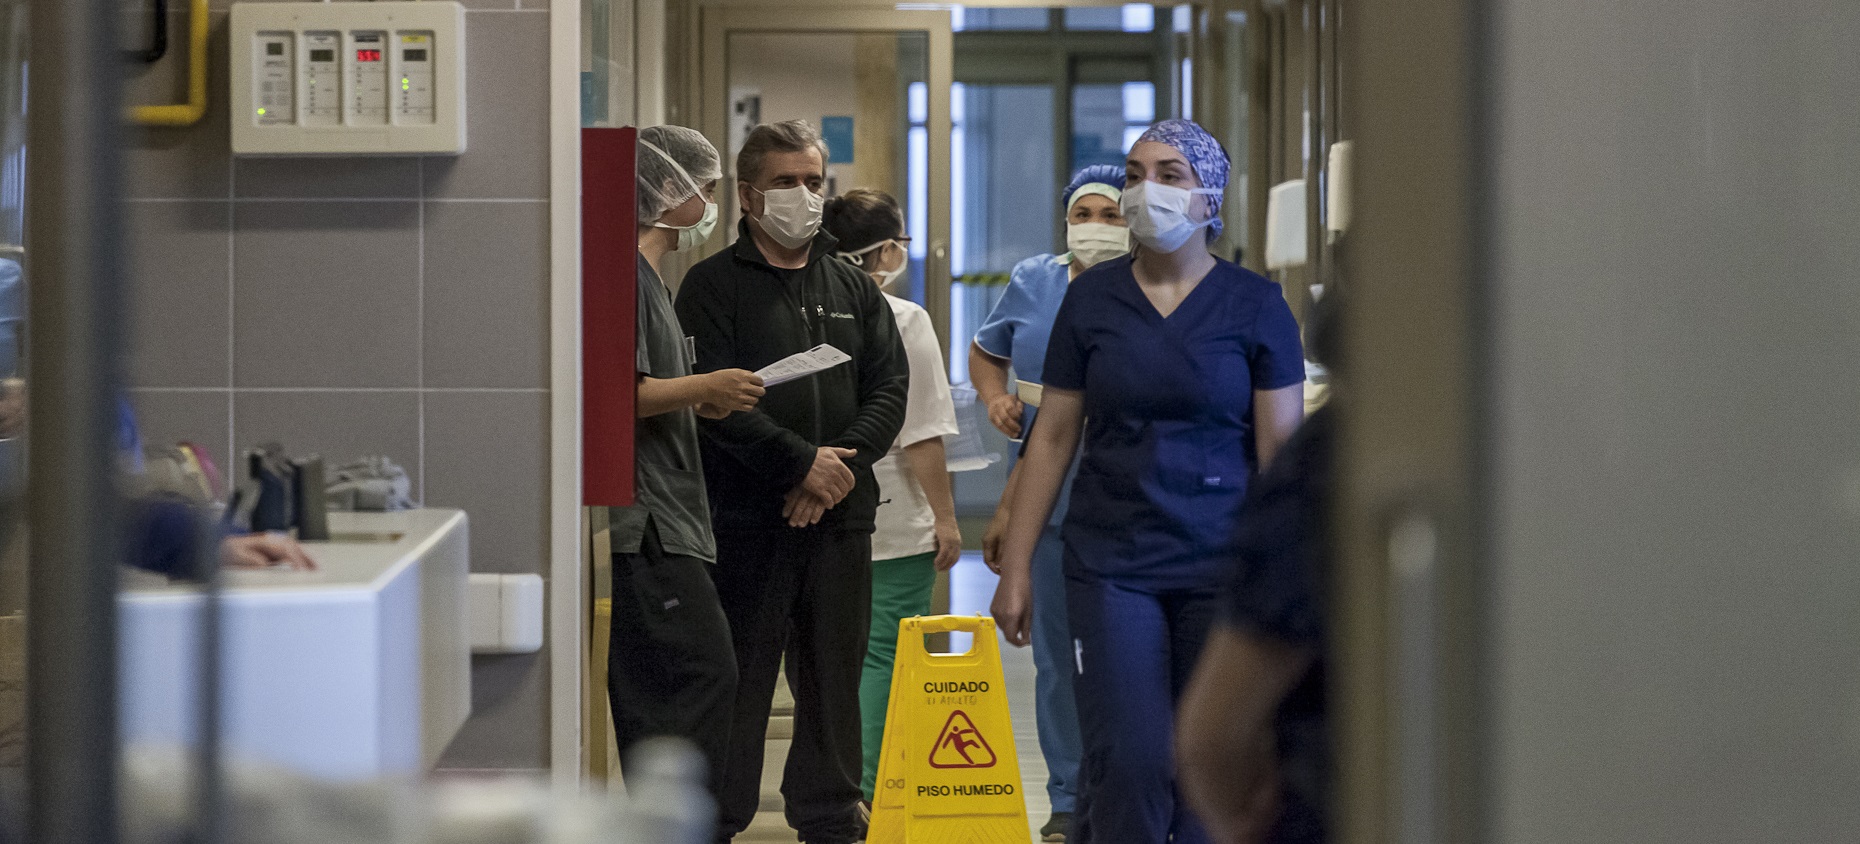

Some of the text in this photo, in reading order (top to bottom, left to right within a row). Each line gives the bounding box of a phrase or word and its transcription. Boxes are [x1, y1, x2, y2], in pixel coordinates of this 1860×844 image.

[923, 681, 990, 694] CUIDADO
[917, 783, 1014, 797] PISO HUMEDO
